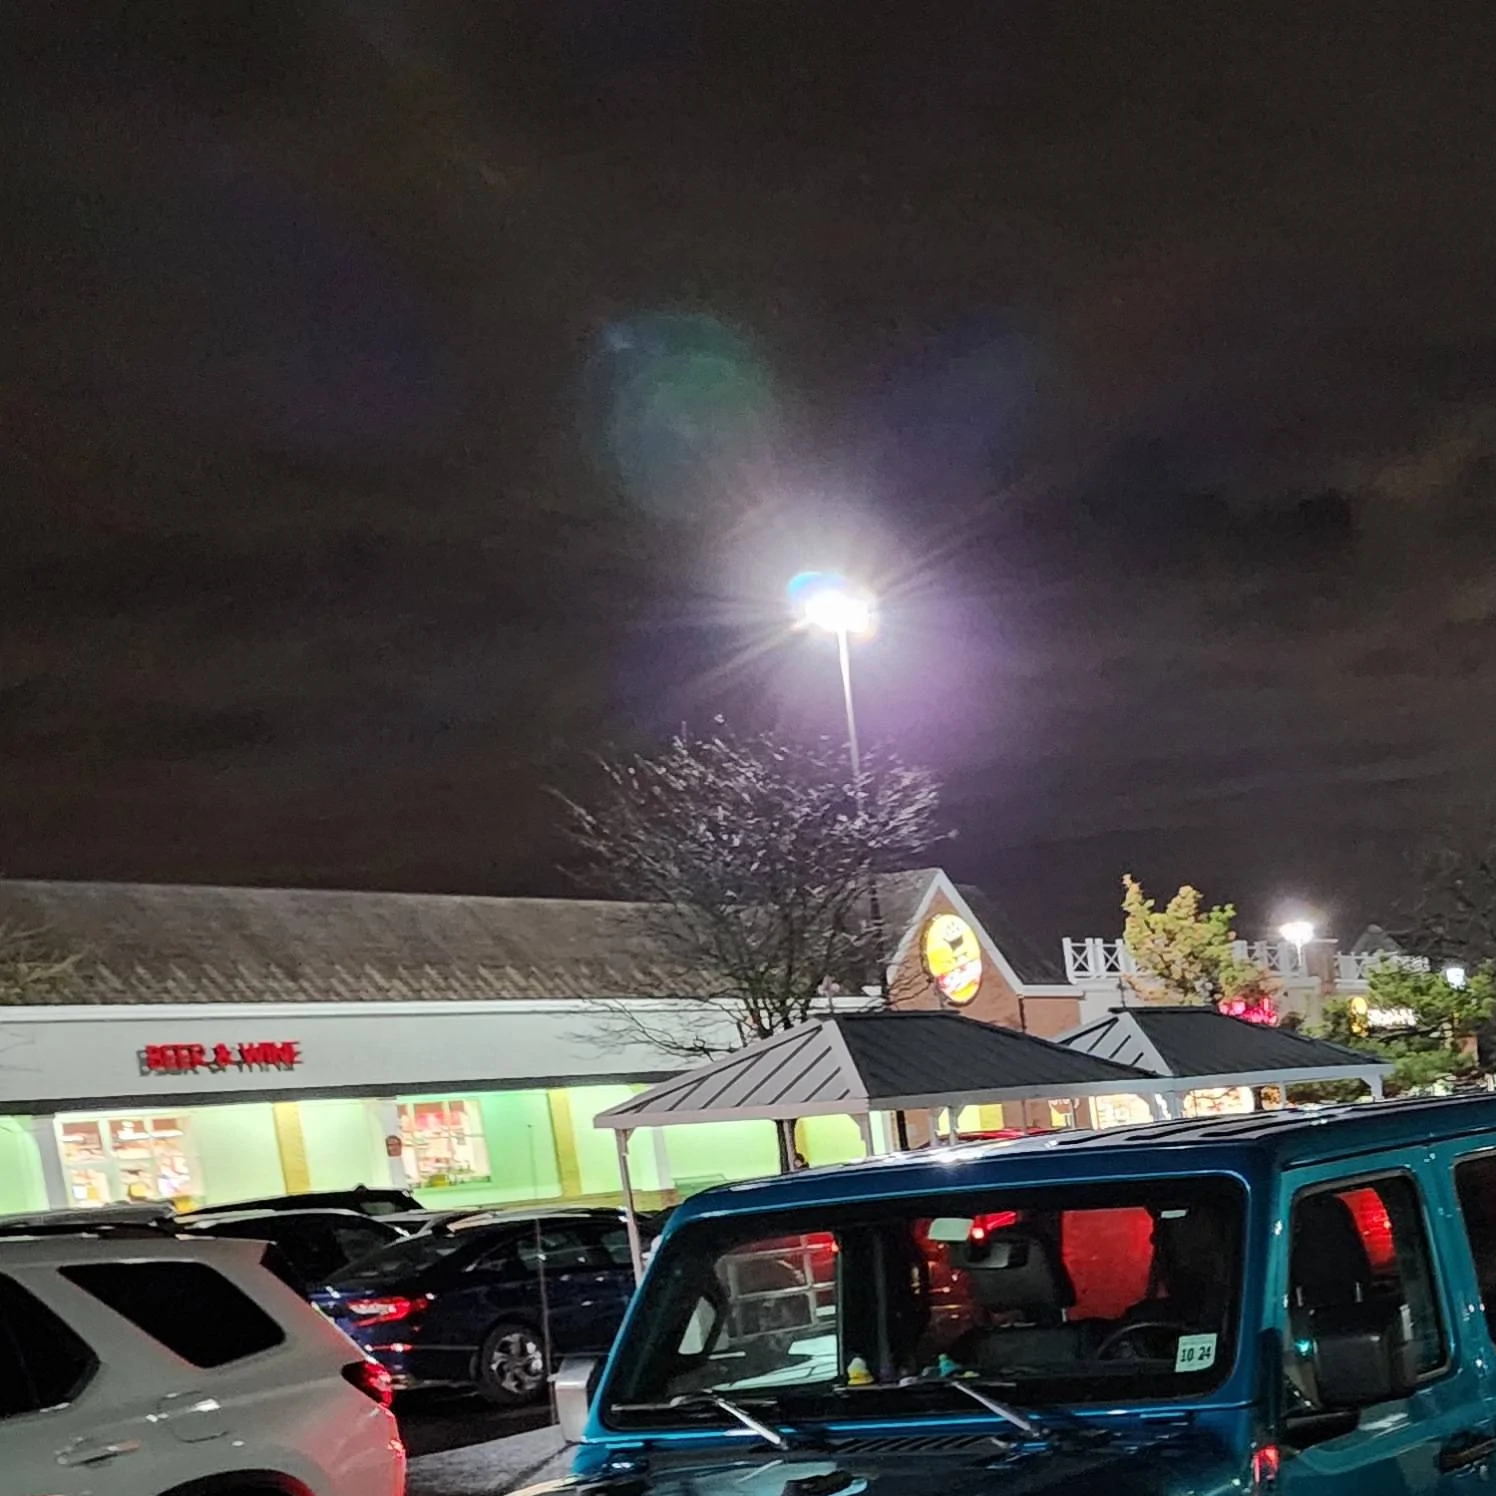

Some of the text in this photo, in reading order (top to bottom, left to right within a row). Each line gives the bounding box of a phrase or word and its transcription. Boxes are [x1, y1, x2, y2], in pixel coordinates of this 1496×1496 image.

[142, 1043, 206, 1073] BEER
[238, 1041, 302, 1069] WINE
[1180, 1346, 1212, 1363] 10 24
